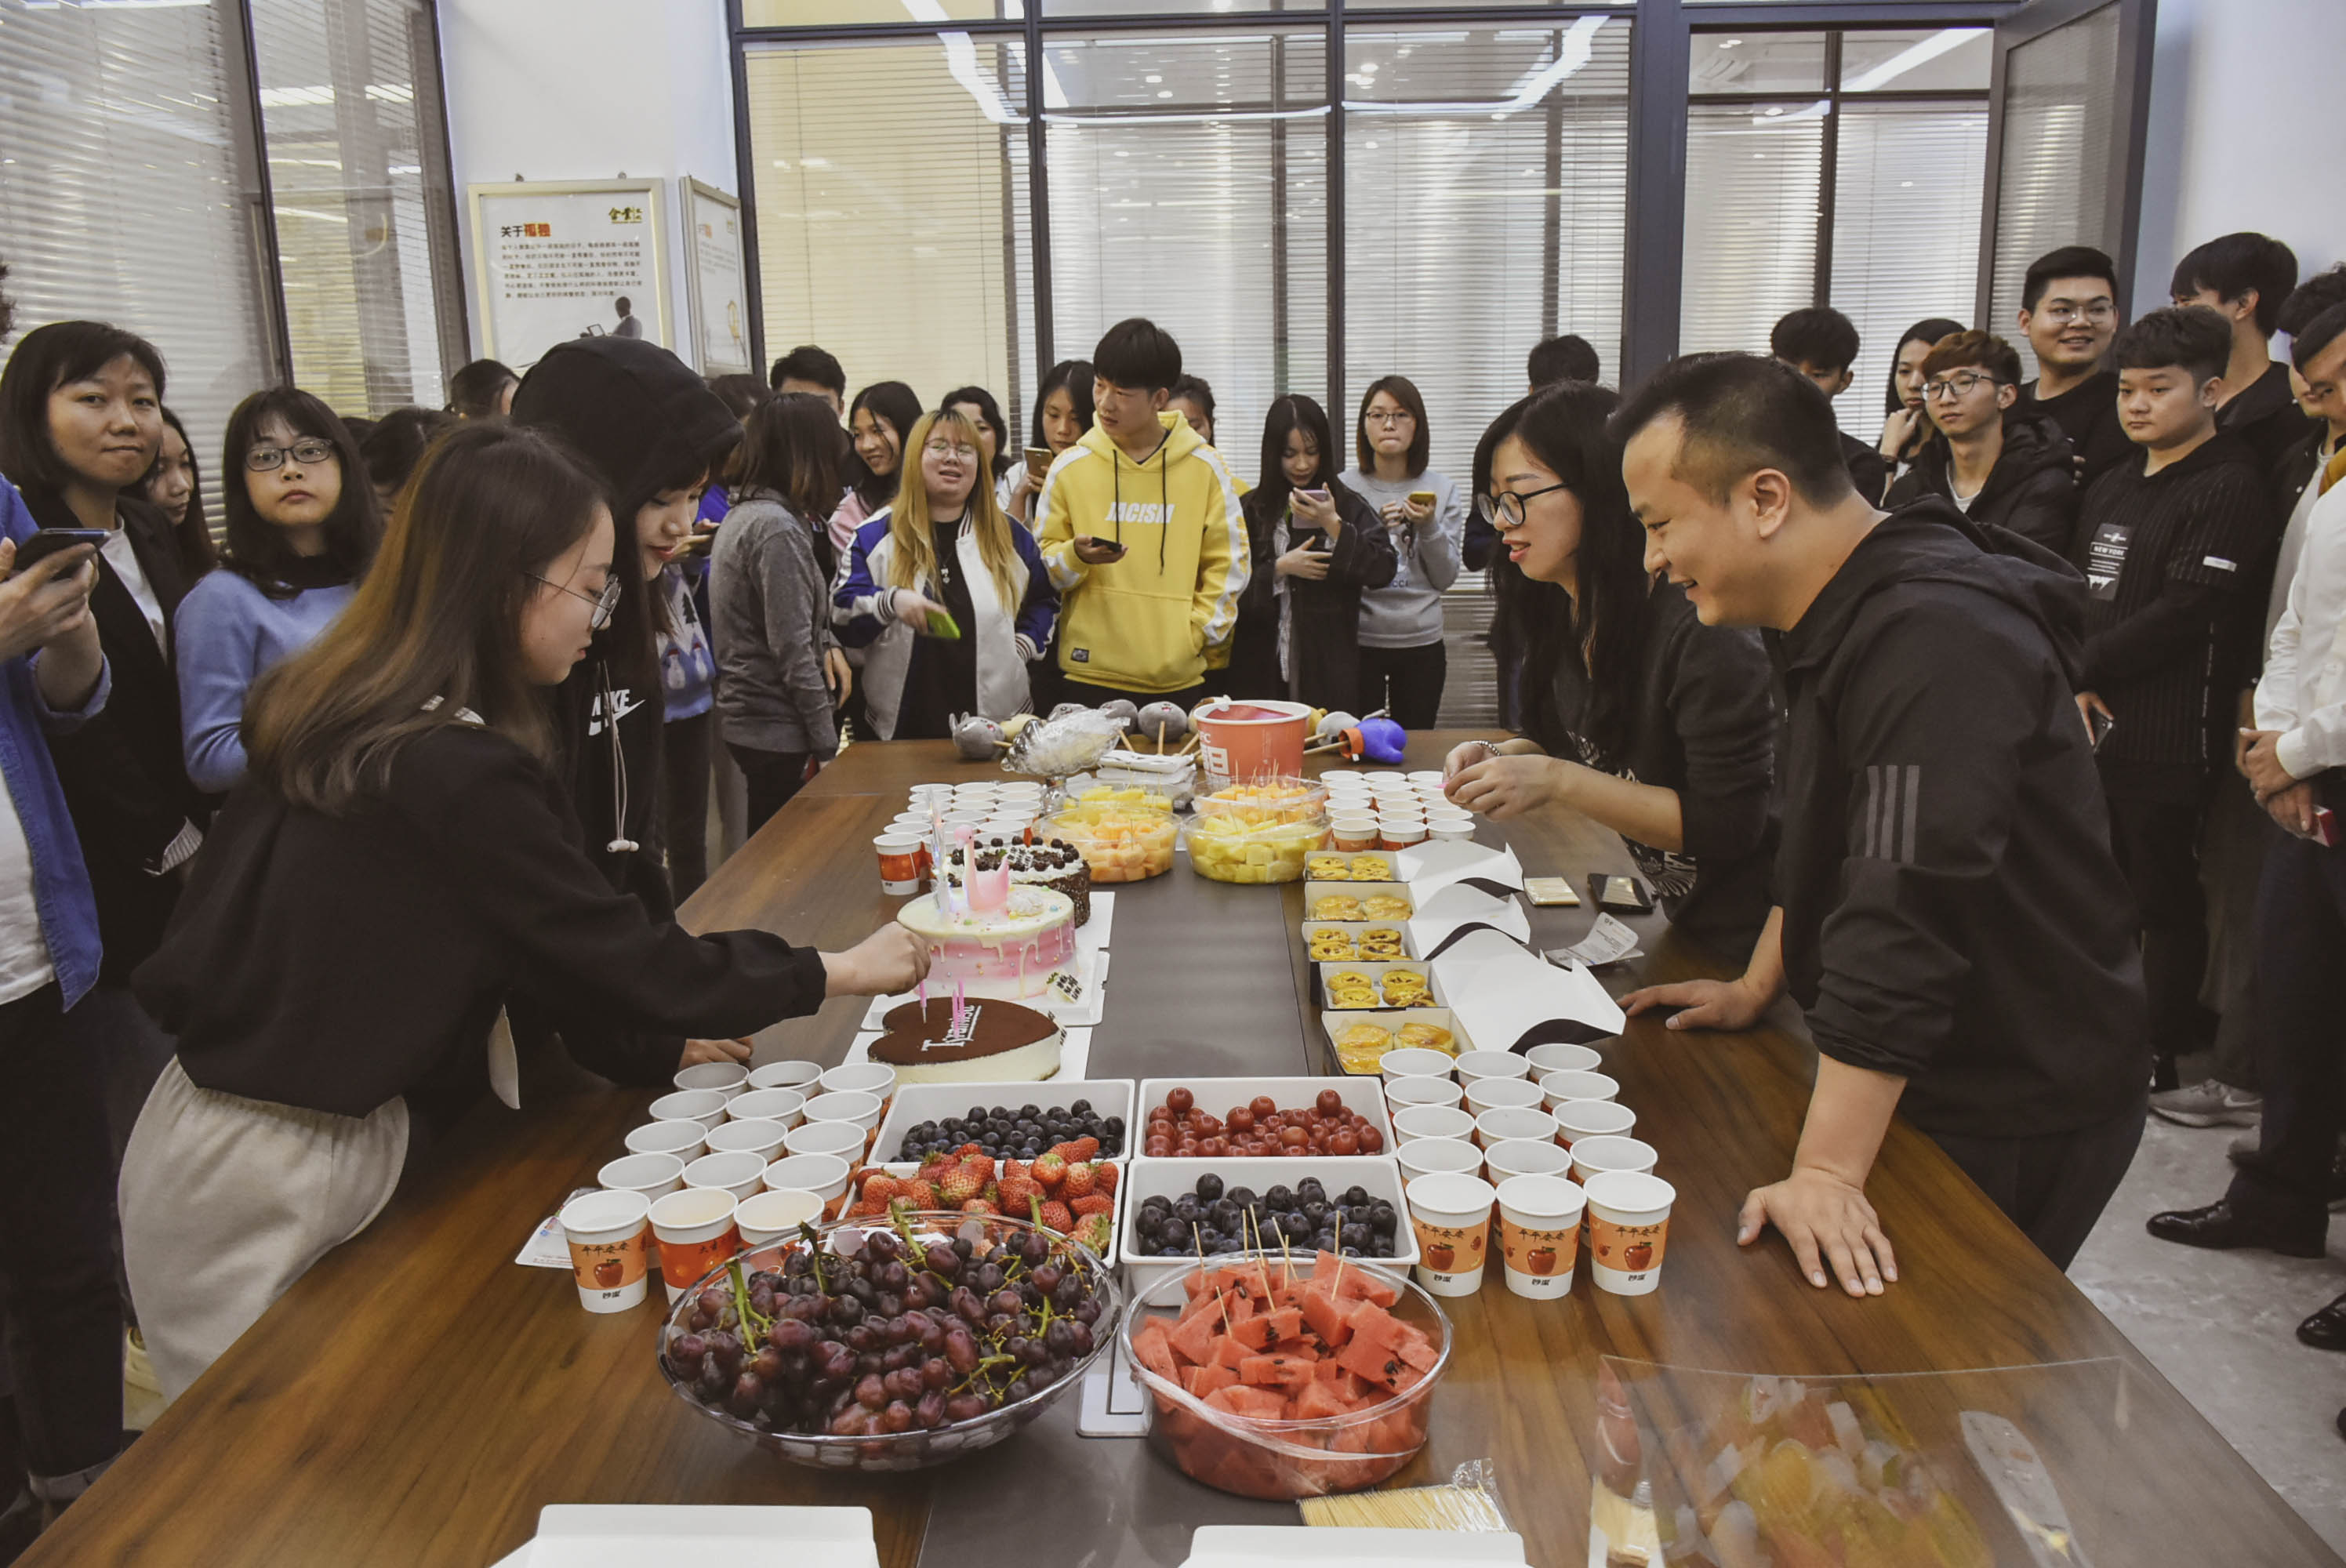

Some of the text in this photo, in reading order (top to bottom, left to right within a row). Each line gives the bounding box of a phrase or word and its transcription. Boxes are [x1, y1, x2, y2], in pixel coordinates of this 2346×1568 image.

[1421, 1223, 1466, 1240] 平平安安
[1518, 1229, 1566, 1243] 平平安安
[1615, 1224, 1661, 1239] 平平安安
[581, 1242, 629, 1258] 平平安安
